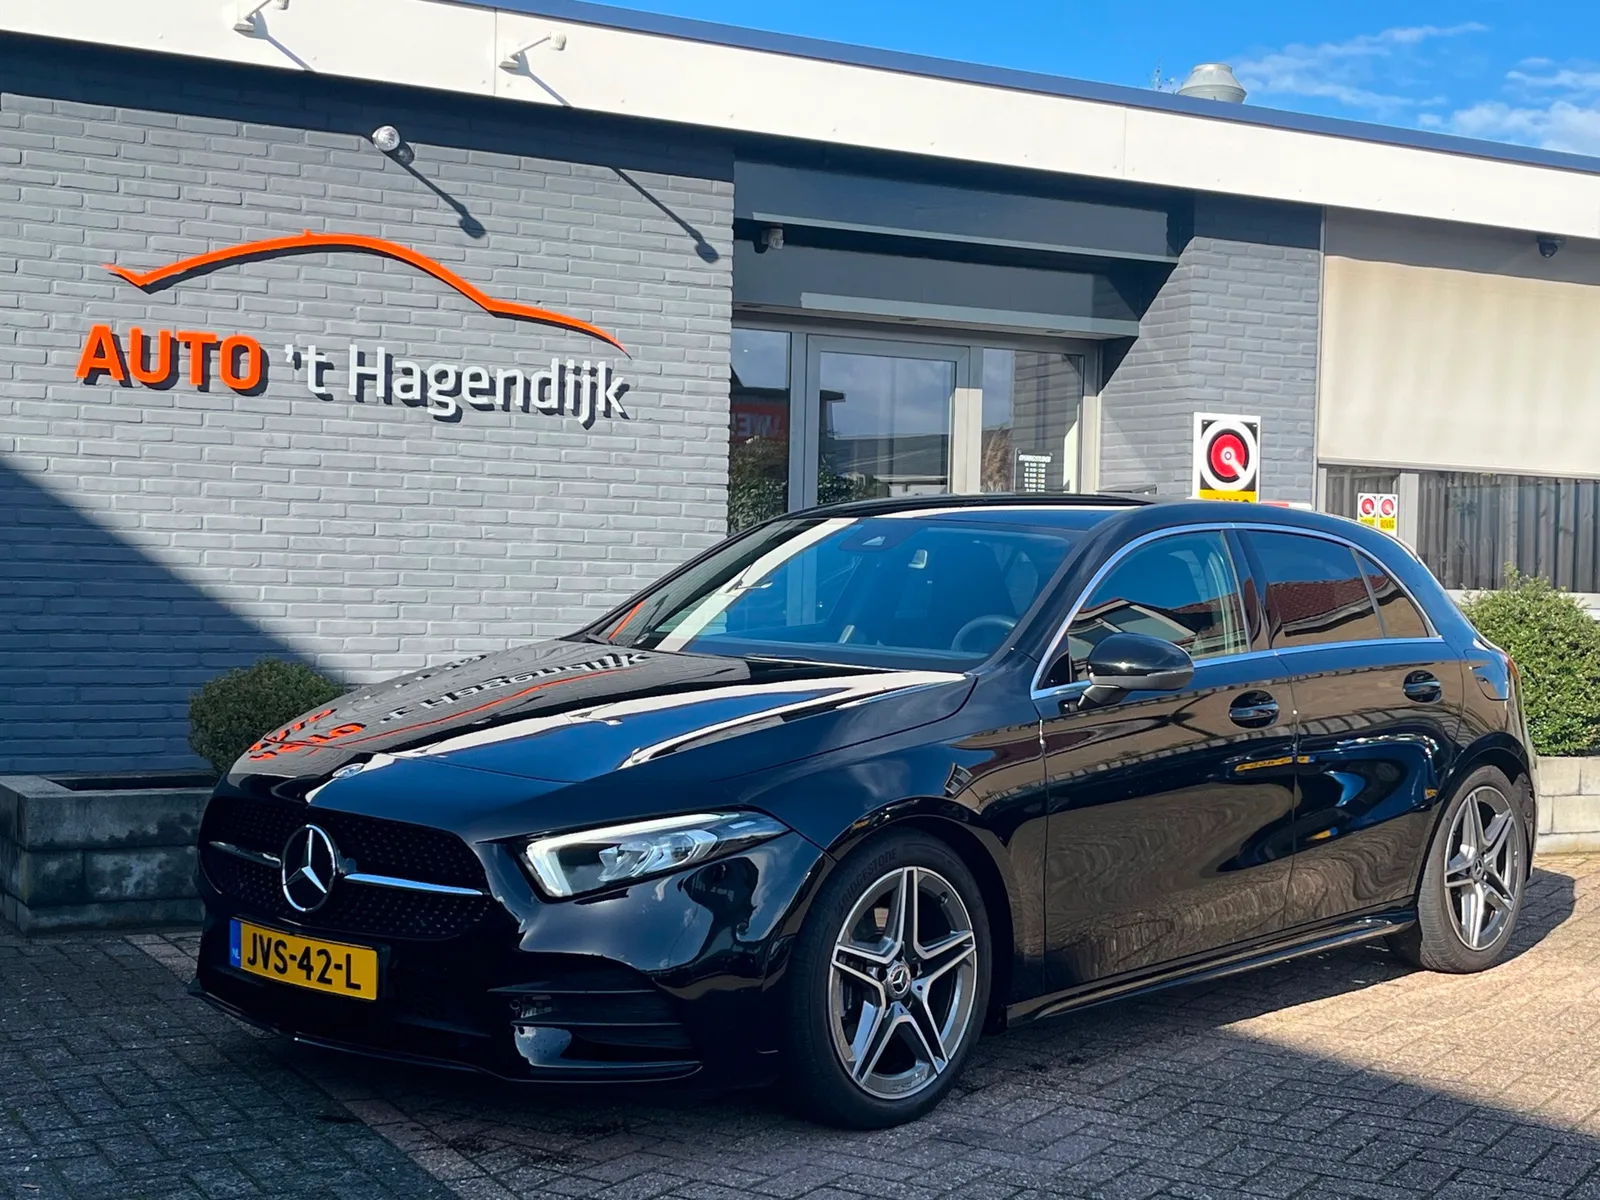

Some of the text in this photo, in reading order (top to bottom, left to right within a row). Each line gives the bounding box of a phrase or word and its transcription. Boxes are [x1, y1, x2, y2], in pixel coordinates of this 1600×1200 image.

[74, 323, 262, 390] AUTO
[348, 344, 625, 425] Hagendijk
[247, 932, 362, 991] JVS-42-L
